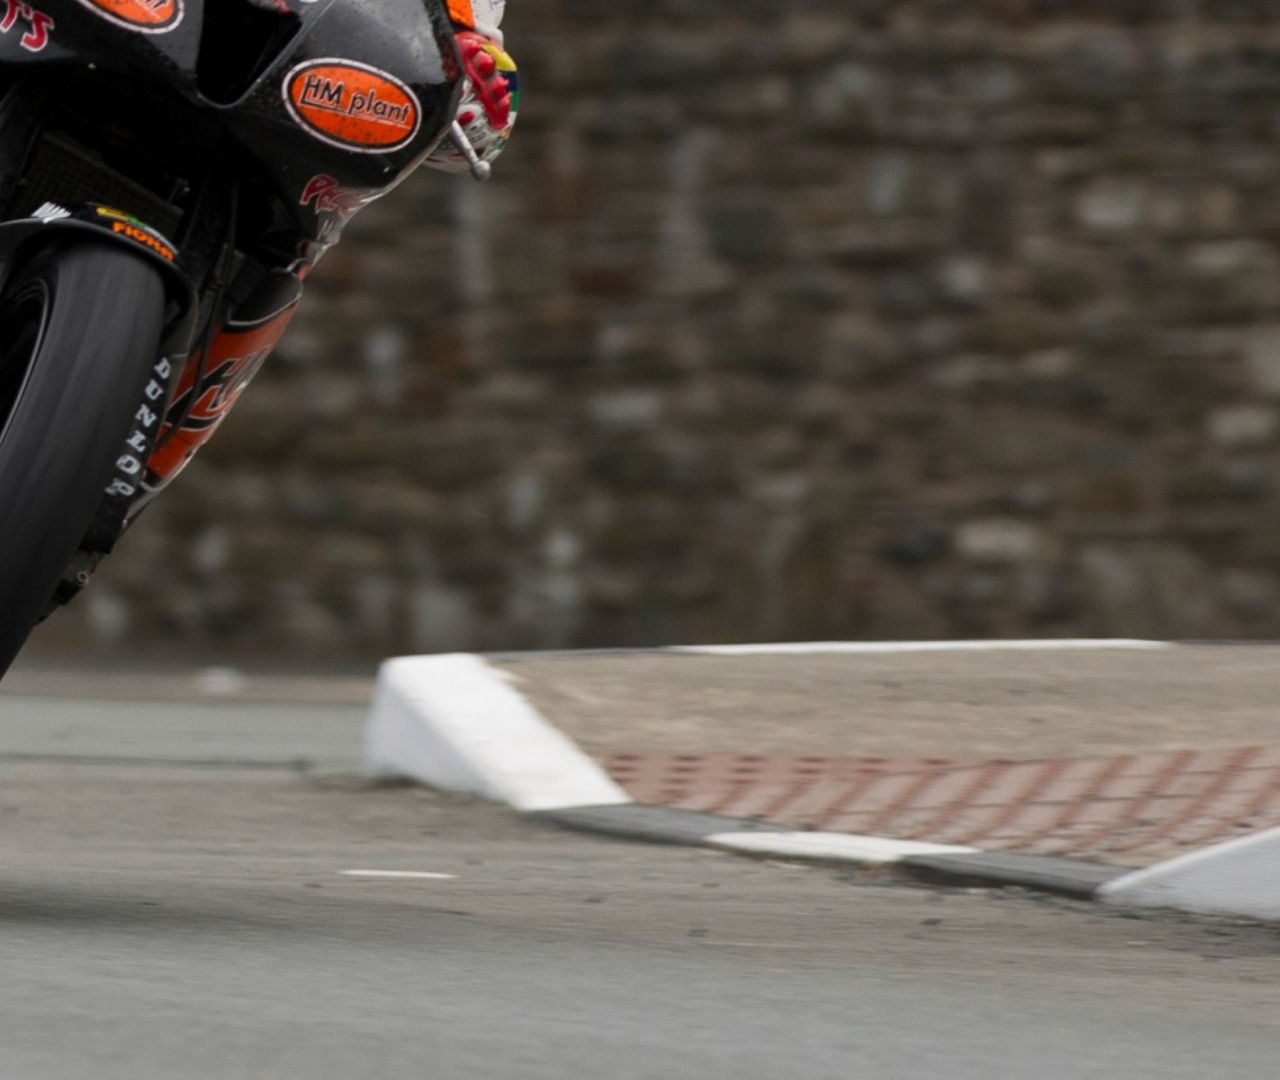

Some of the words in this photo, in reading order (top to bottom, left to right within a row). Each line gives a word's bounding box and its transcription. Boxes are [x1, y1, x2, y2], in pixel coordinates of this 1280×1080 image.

[300, 76, 343, 110] HM
[347, 89, 411, 122] plant
[104, 357, 173, 497] DUNLOP
